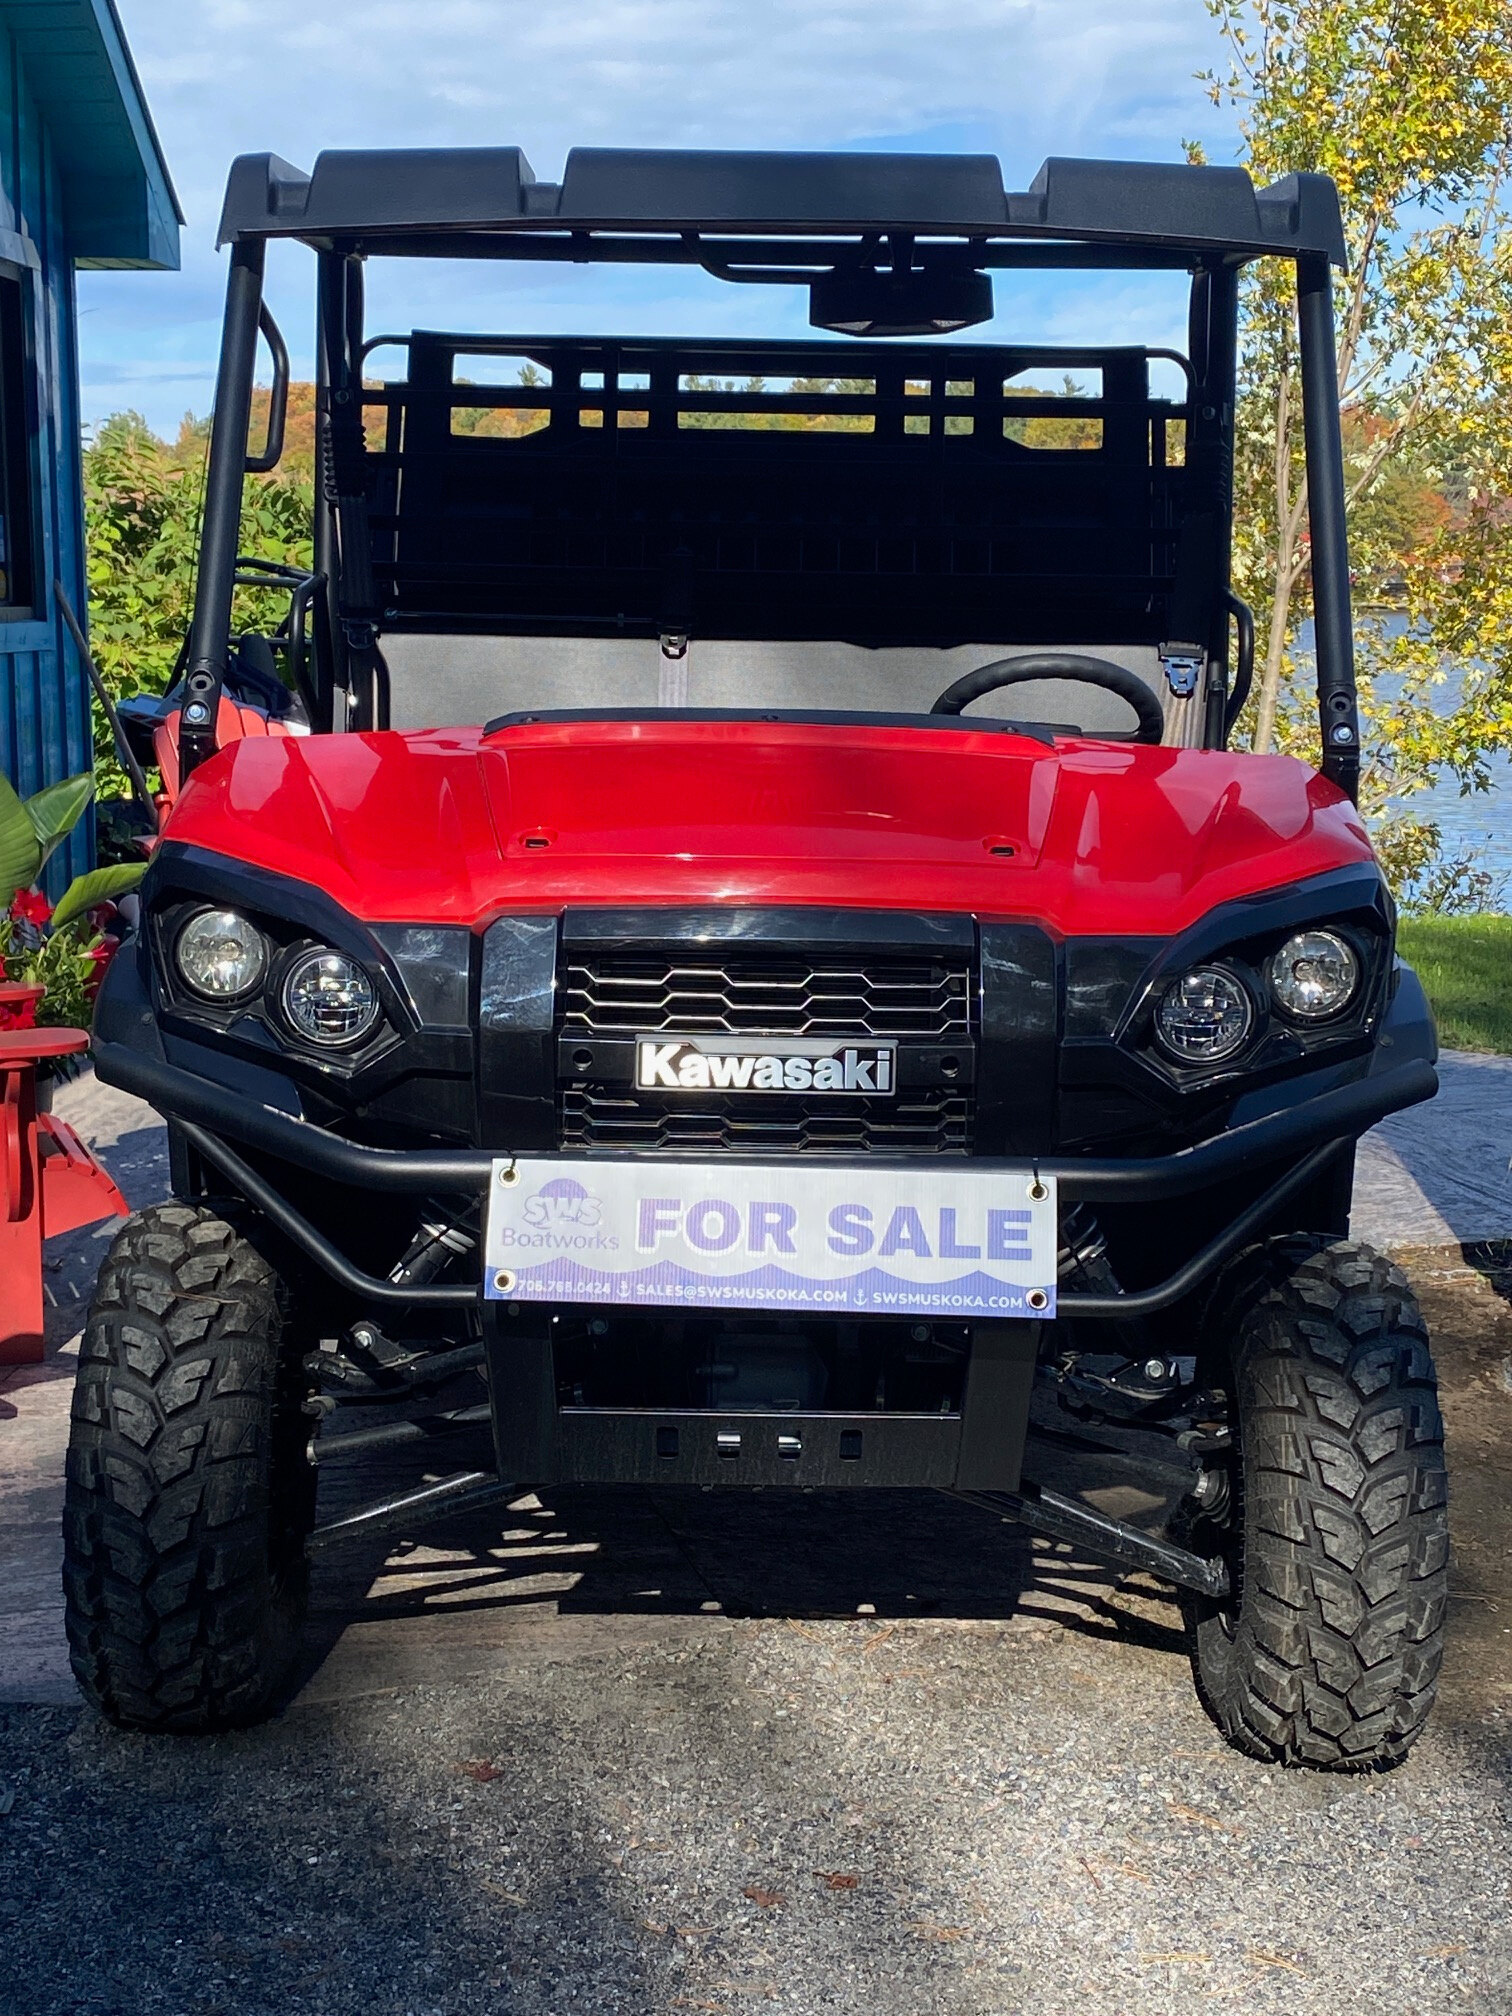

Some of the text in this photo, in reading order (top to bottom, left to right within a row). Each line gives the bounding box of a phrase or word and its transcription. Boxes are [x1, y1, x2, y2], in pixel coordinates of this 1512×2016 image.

[640, 1043, 890, 1090] Kawasaki
[522, 1194, 603, 1228] SWS
[502, 1227, 620, 1250] Boatworks
[635, 1198, 1033, 1261] FOR SALE
[637, 1284, 848, 1302] SALES@SWSMUSKOKA.COM
[873, 1292, 1023, 1309] SWSMUSKOKA.COM
